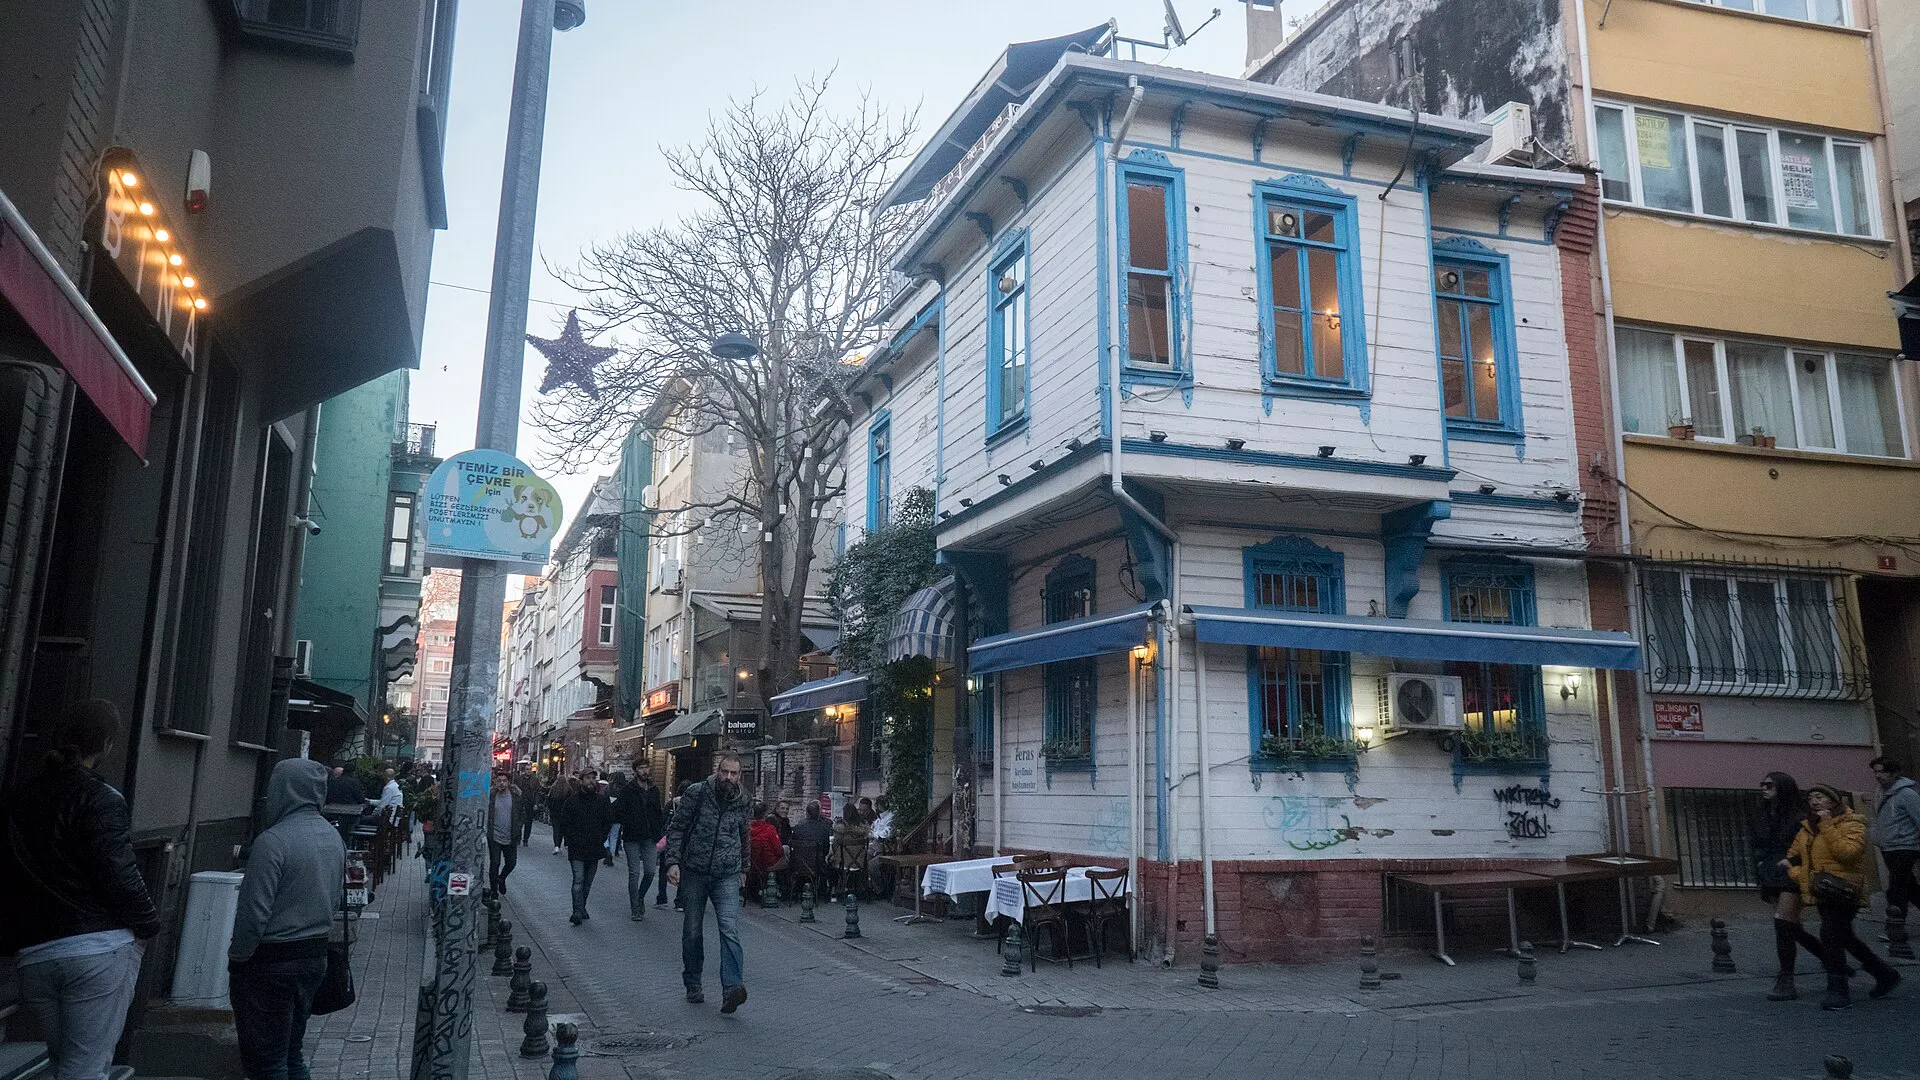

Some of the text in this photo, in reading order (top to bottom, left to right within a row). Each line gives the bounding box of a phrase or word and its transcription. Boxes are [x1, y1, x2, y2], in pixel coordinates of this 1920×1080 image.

[457, 461, 525, 478] TEMİZ BİR
[467, 474, 511, 487] ÇEVRE
[728, 721, 756, 729] bahane
